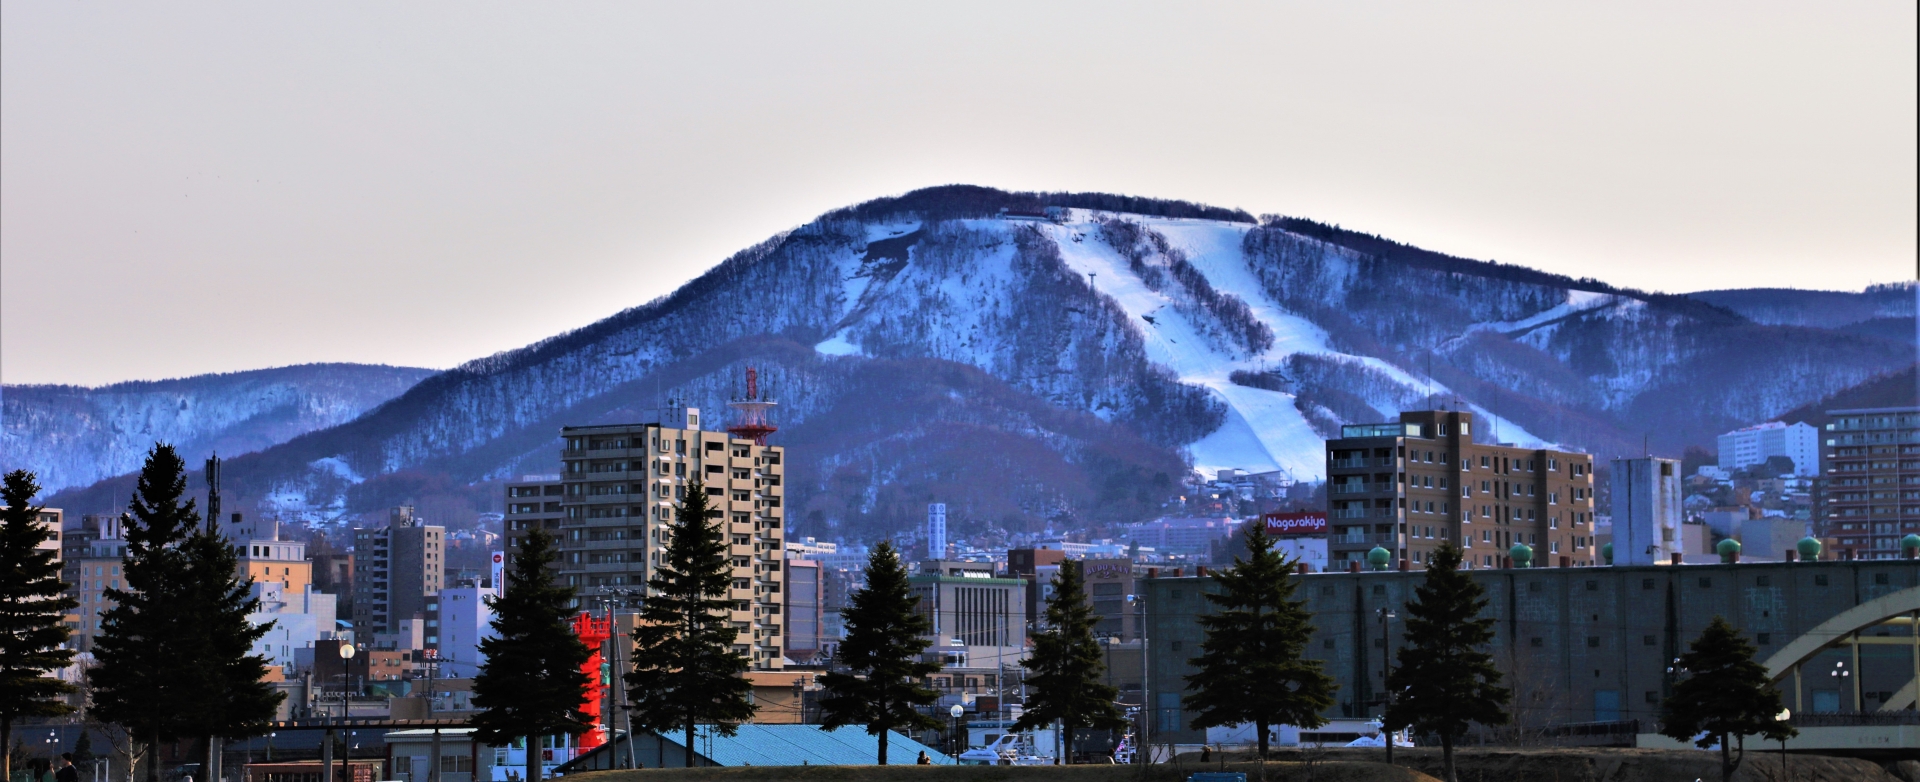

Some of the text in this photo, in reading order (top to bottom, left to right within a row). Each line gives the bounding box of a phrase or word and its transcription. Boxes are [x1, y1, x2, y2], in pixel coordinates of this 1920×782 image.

[1267, 516, 1326, 531] Nagasakiya
[1103, 571, 1110, 579] 2
[1042, 584, 1054, 600] P
